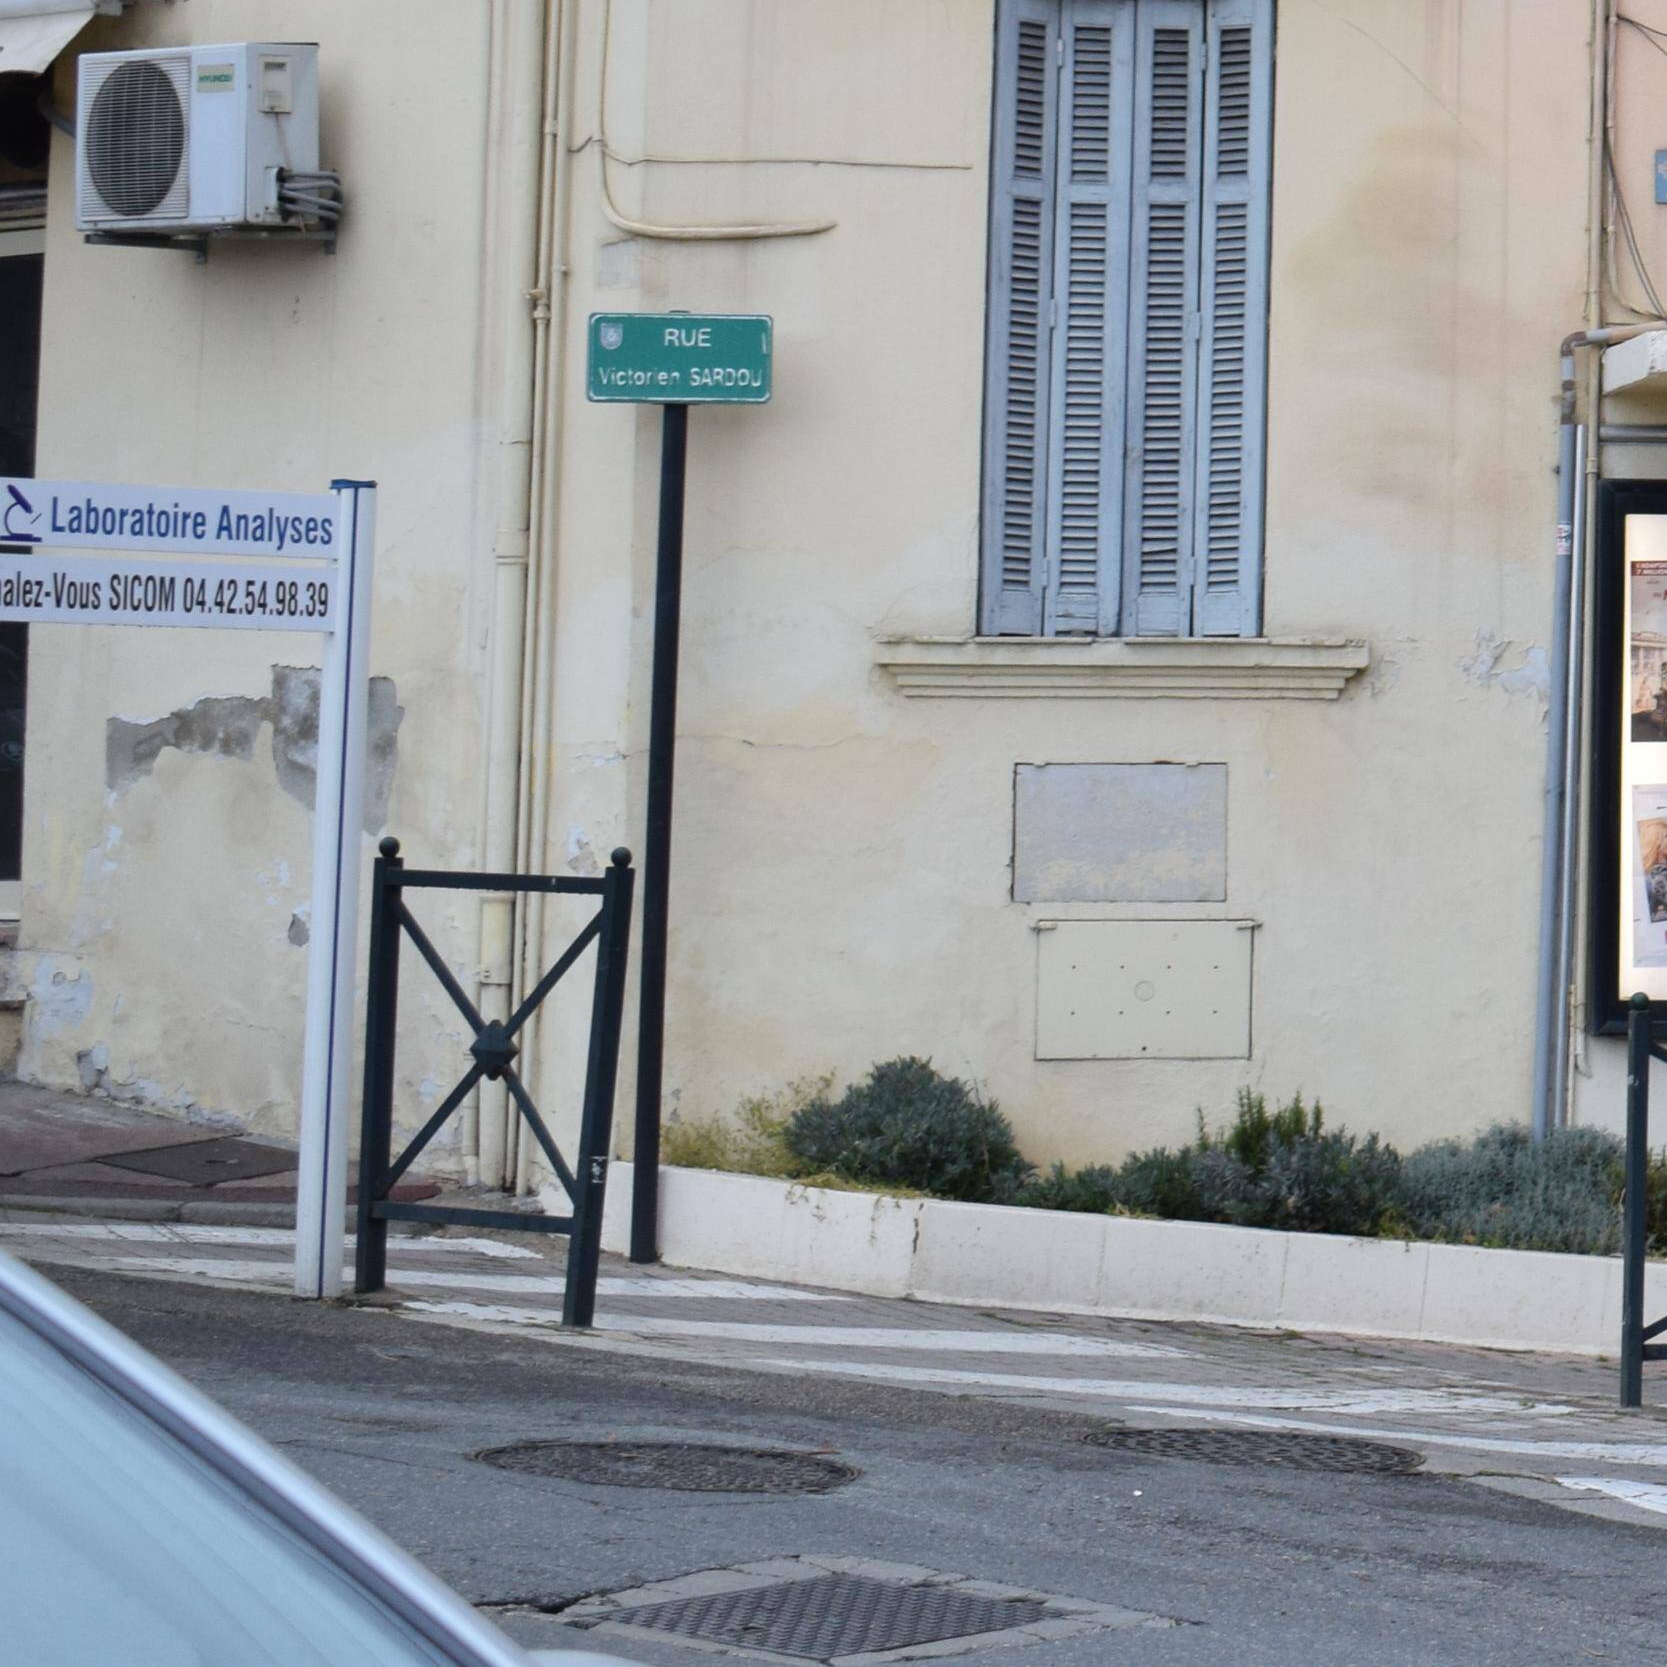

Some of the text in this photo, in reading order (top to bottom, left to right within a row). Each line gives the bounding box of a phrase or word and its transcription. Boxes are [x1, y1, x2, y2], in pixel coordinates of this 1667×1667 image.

[664, 328, 712, 347] RUE
[598, 366, 763, 387] Victorien SARDOU
[51, 496, 333, 551] Laboratoire Analyses
[109, 572, 176, 613] SICOM
[182, 576, 329, 618] 04.42.54.98.39
